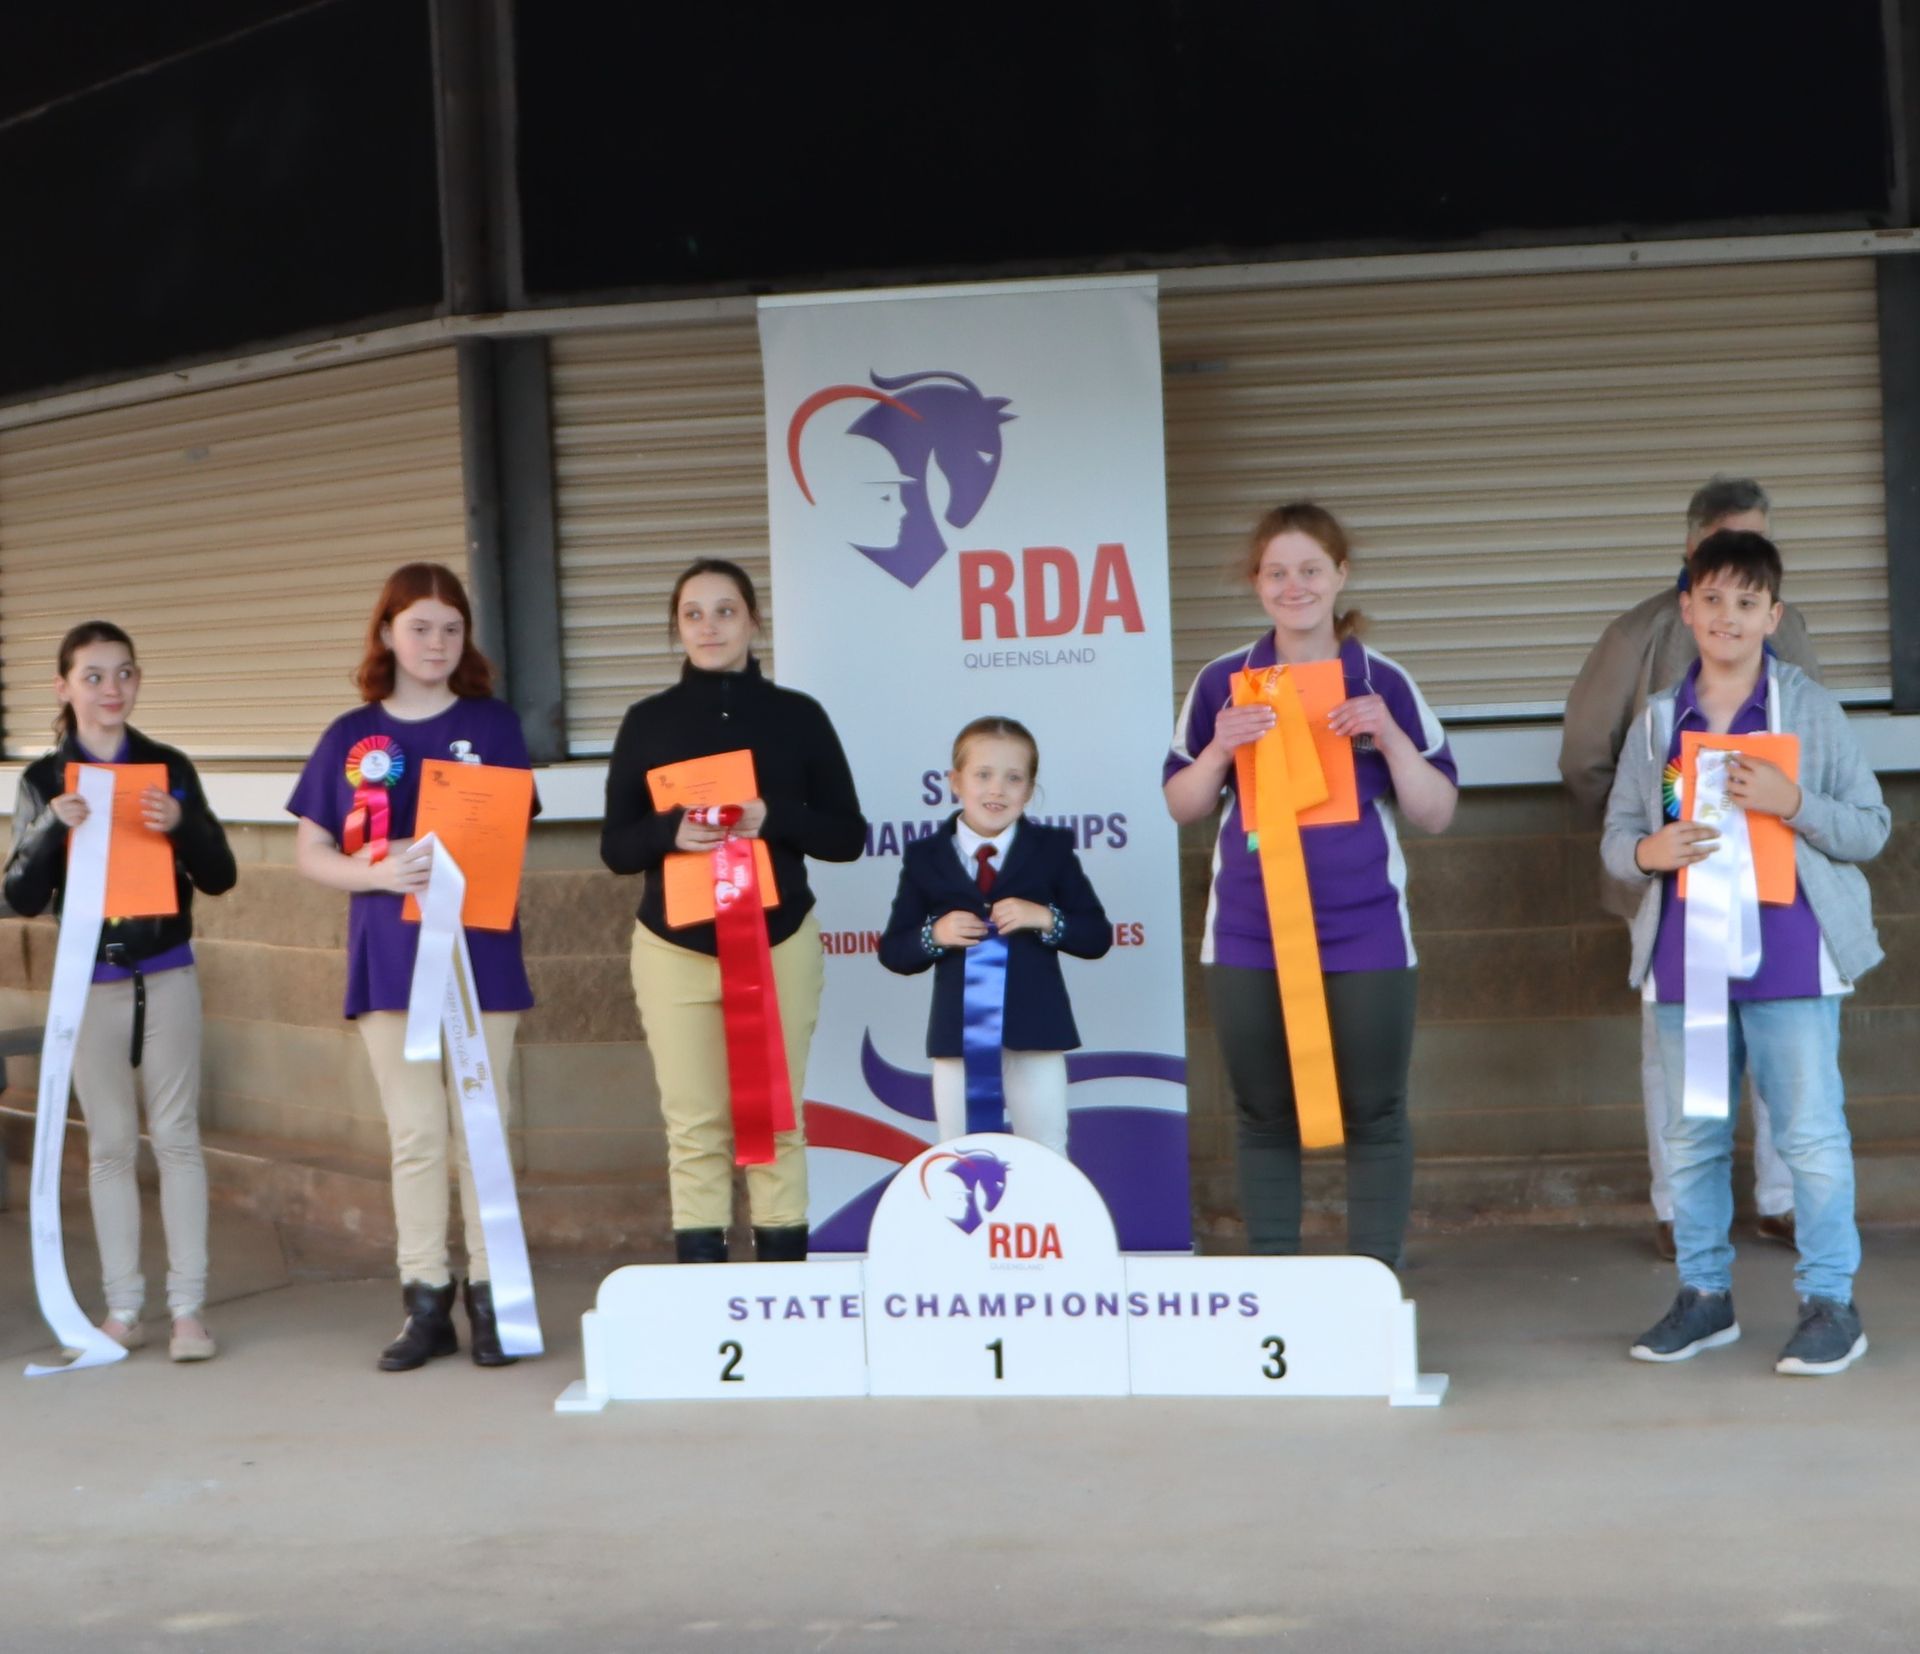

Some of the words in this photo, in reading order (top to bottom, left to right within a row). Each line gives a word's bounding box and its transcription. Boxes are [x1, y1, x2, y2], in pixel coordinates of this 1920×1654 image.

[958, 543, 1145, 641] RDA
[964, 648, 1096, 669] QUEENSLAND
[819, 931, 882, 955] RIDIN
[989, 1222, 1064, 1259] RDA
[728, 1294, 862, 1321] STATE
[884, 1291, 1261, 1319] CHAMPIONSHIPS
[718, 1340, 745, 1382] 2
[984, 1338, 1005, 1380] 1
[1261, 1336, 1288, 1380] 3
